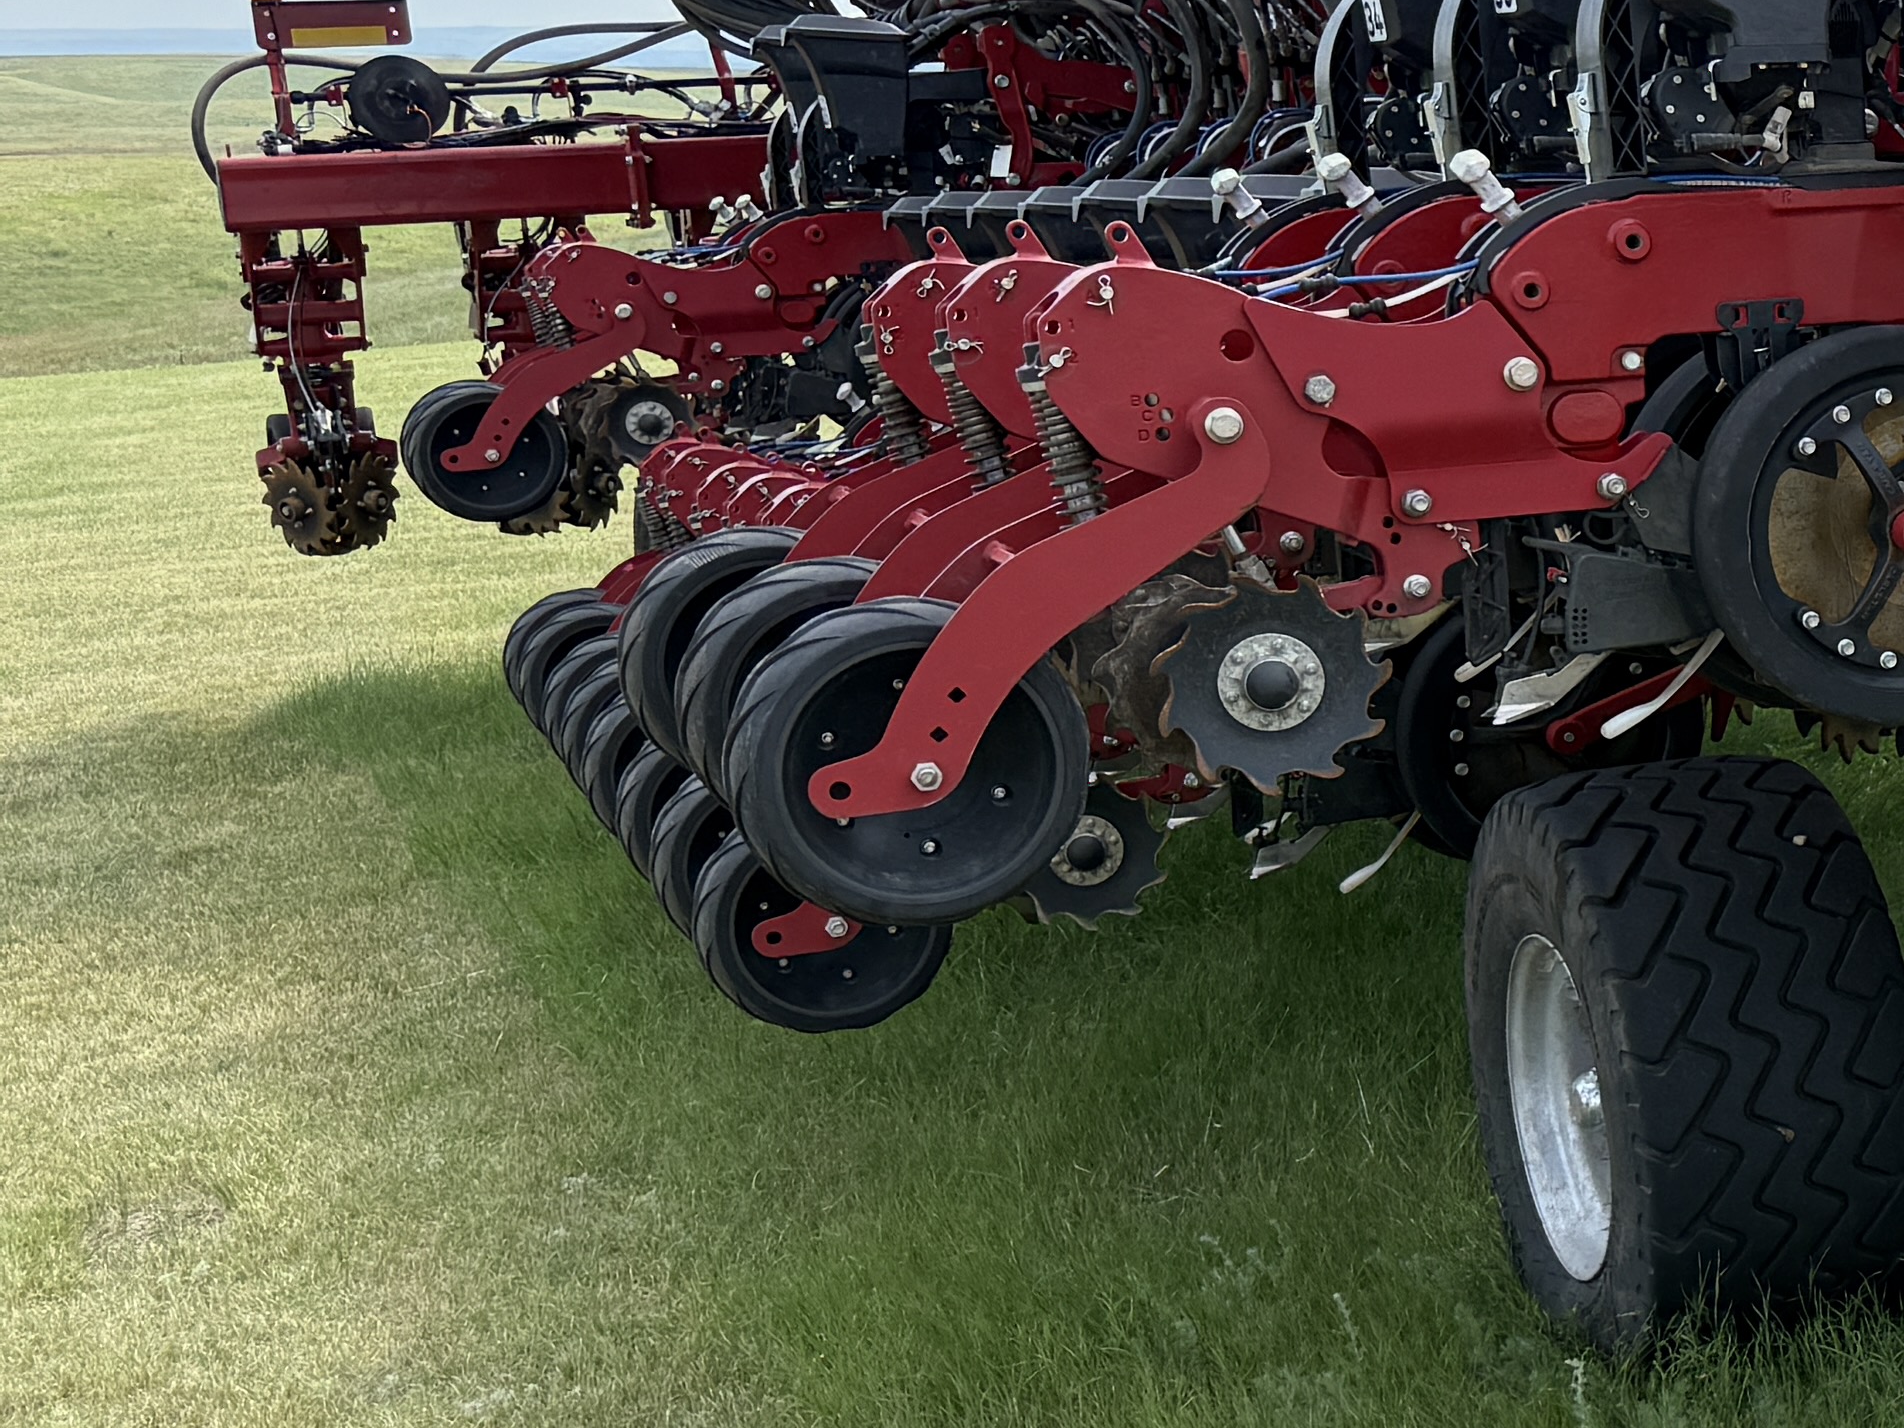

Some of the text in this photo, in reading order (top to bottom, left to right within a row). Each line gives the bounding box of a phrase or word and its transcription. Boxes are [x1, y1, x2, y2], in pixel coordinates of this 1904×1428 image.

[1364, 1, 1384, 38] 34
[1130, 395, 1142, 406] B
[1142, 410, 1154, 421] C
[1138, 429, 1150, 441] D
